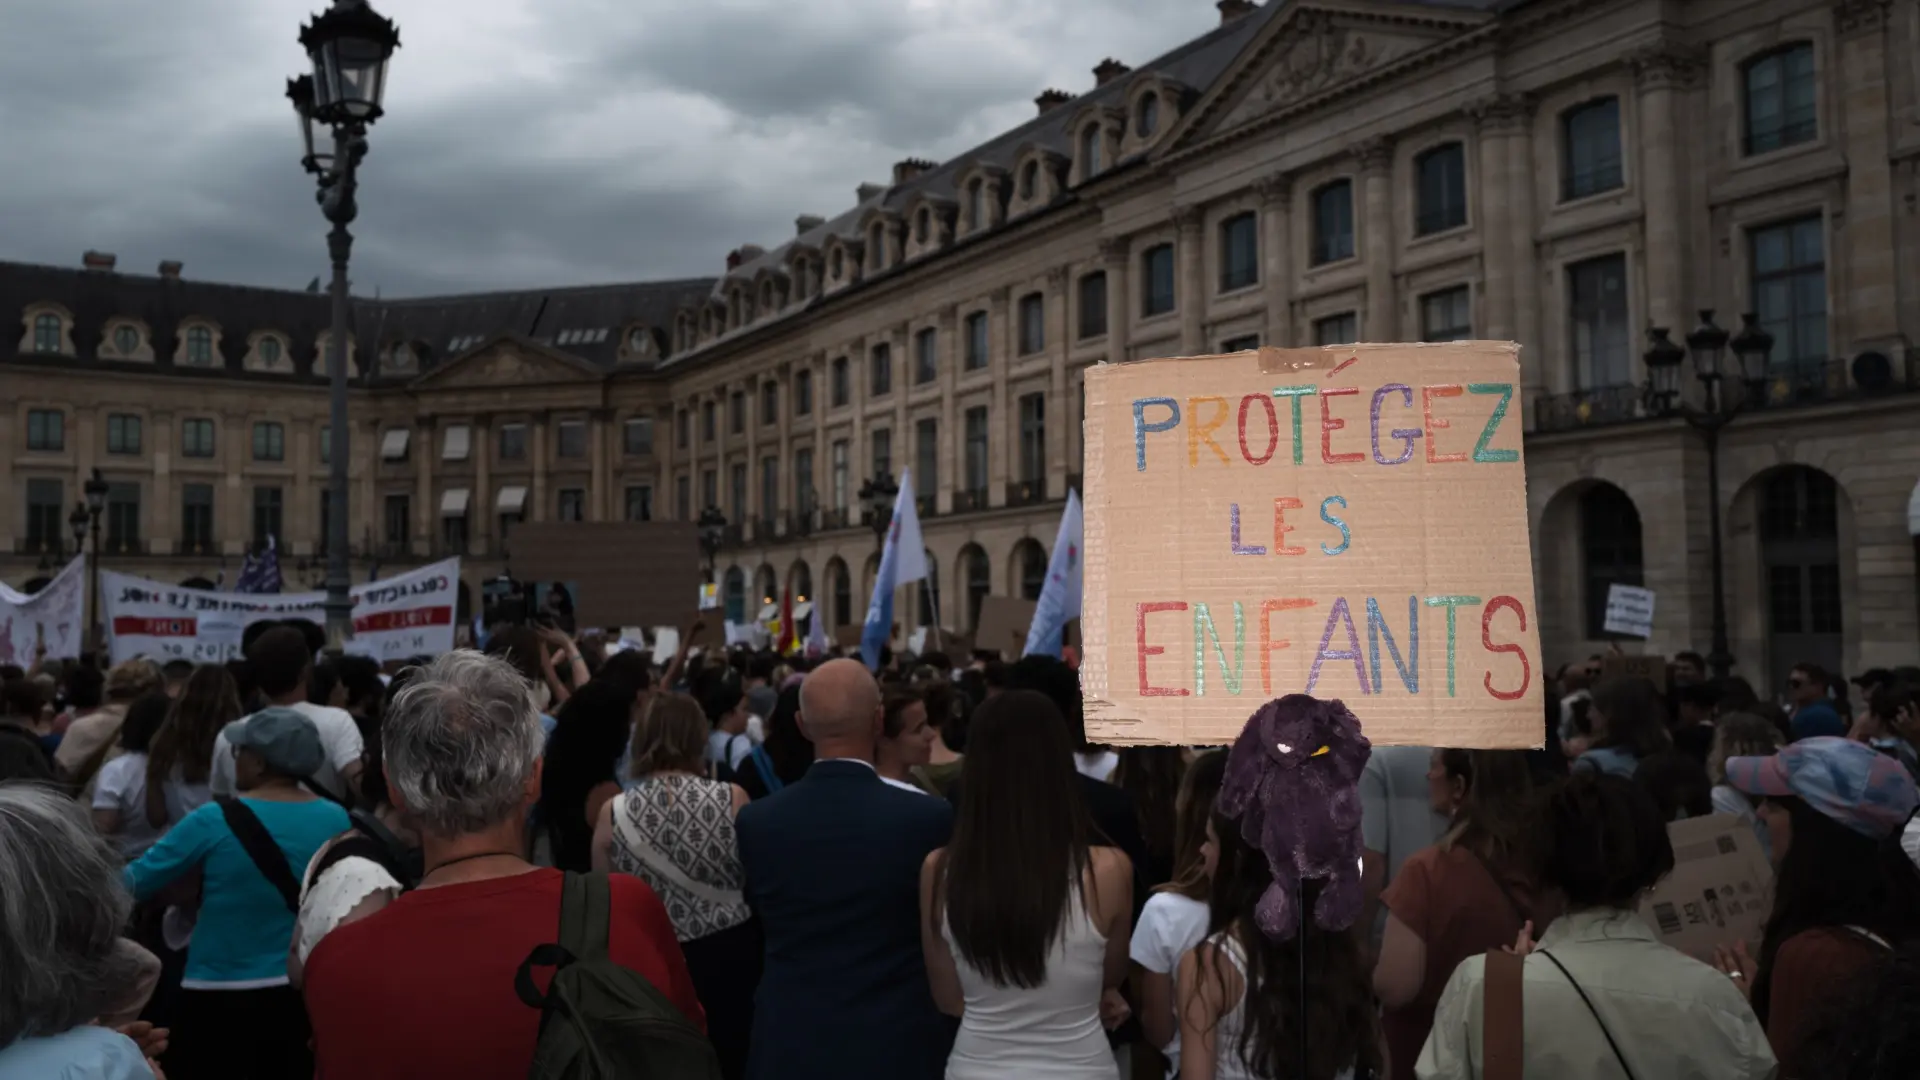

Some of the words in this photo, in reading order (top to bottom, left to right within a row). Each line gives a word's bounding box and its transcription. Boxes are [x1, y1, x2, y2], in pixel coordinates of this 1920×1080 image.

[1132, 357, 1520, 472] PROTÉGEZ
[1230, 495, 1351, 556] LES
[1136, 595, 1531, 701] ENFANTS
